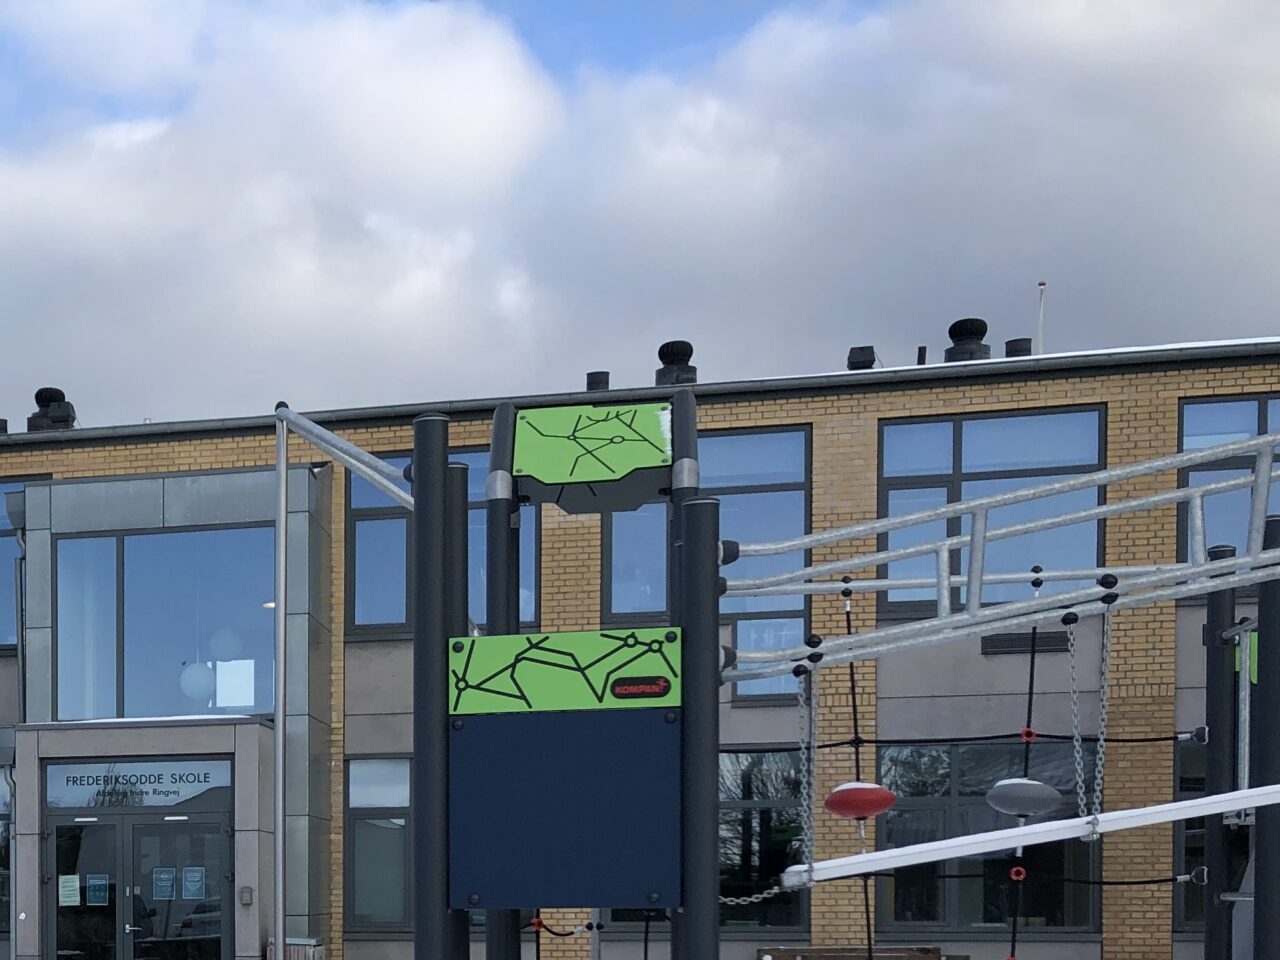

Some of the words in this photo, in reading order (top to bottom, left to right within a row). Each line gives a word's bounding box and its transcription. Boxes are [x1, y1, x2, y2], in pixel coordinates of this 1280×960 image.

[66, 774, 164, 786] FREDERIKSODDE
[170, 772, 210, 784] SKOLE
[130, 788, 150, 797] Indre
[153, 788, 180, 798] Ringvej
